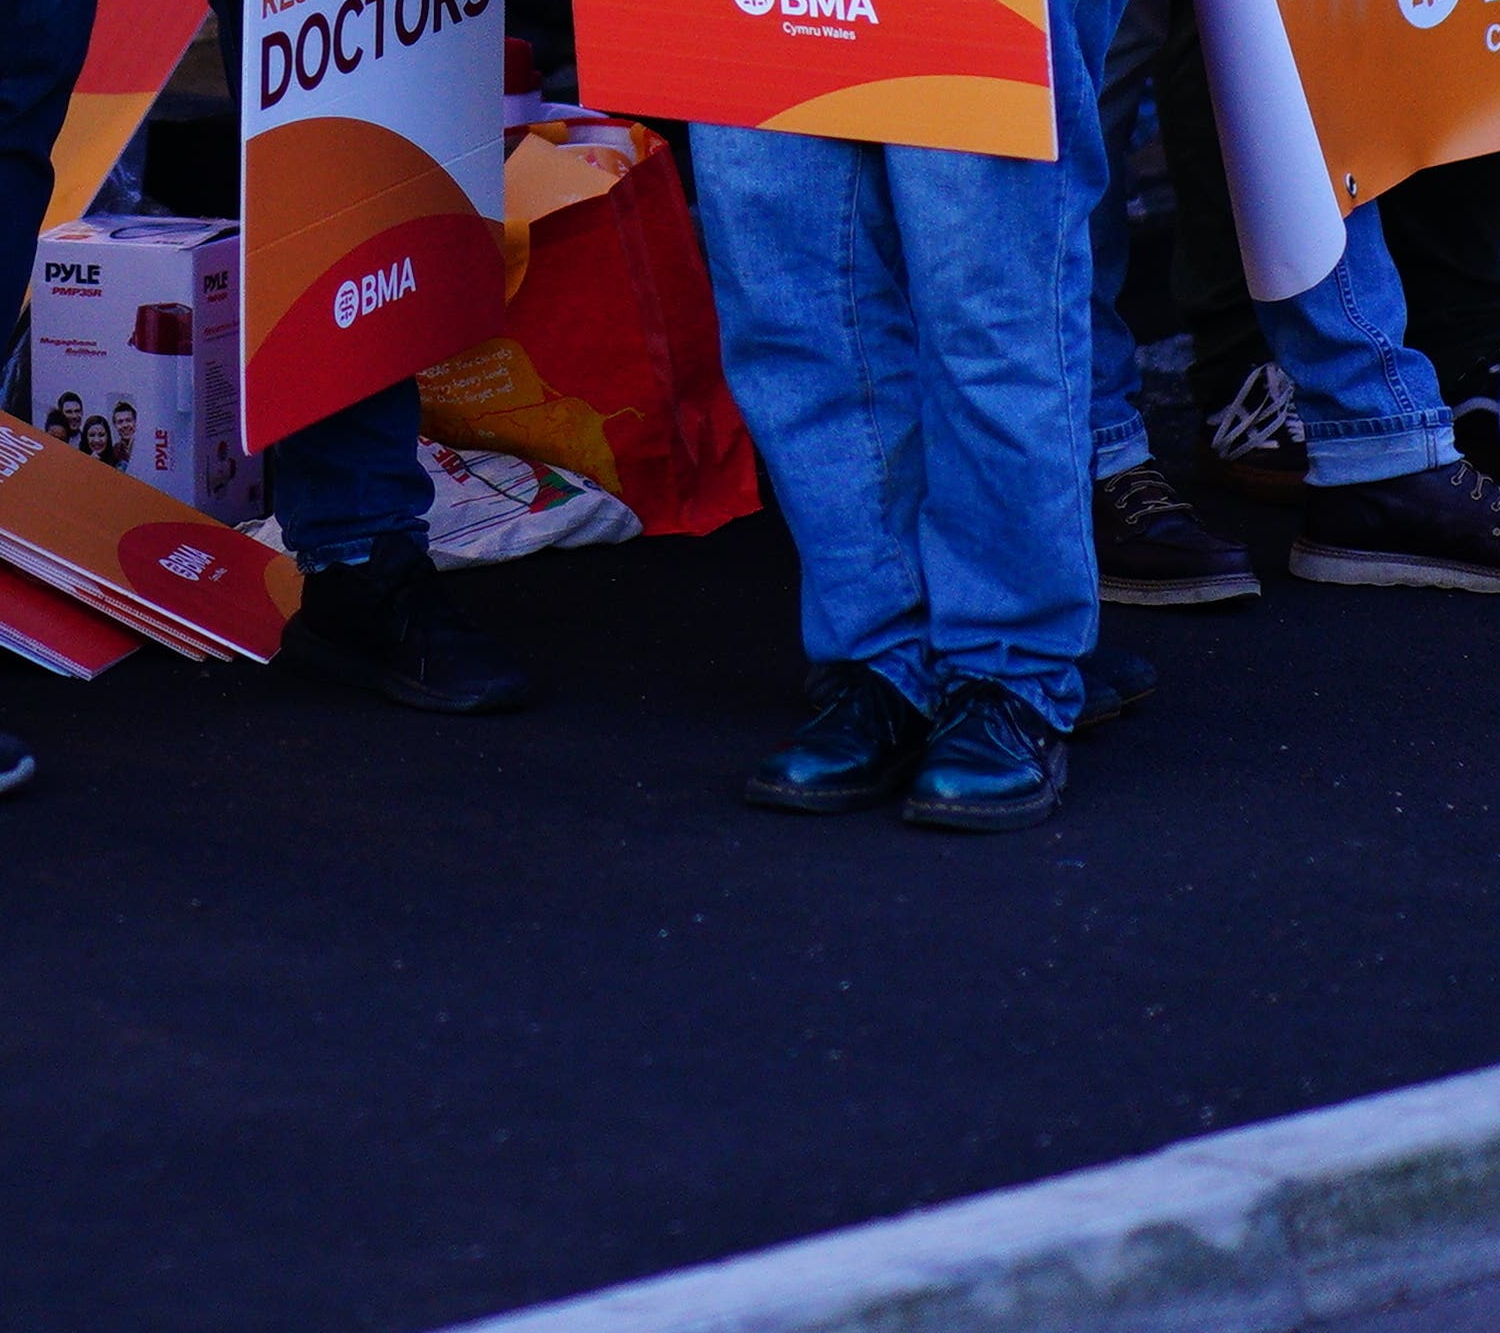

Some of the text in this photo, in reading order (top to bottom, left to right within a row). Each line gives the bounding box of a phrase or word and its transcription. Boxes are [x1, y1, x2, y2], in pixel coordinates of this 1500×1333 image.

[782, 21, 822, 38] Cymru
[45, 262, 102, 285] PYLE
[204, 270, 229, 294] PYLE
[361, 255, 417, 317] BMA
[155, 428, 168, 472] PYLE
